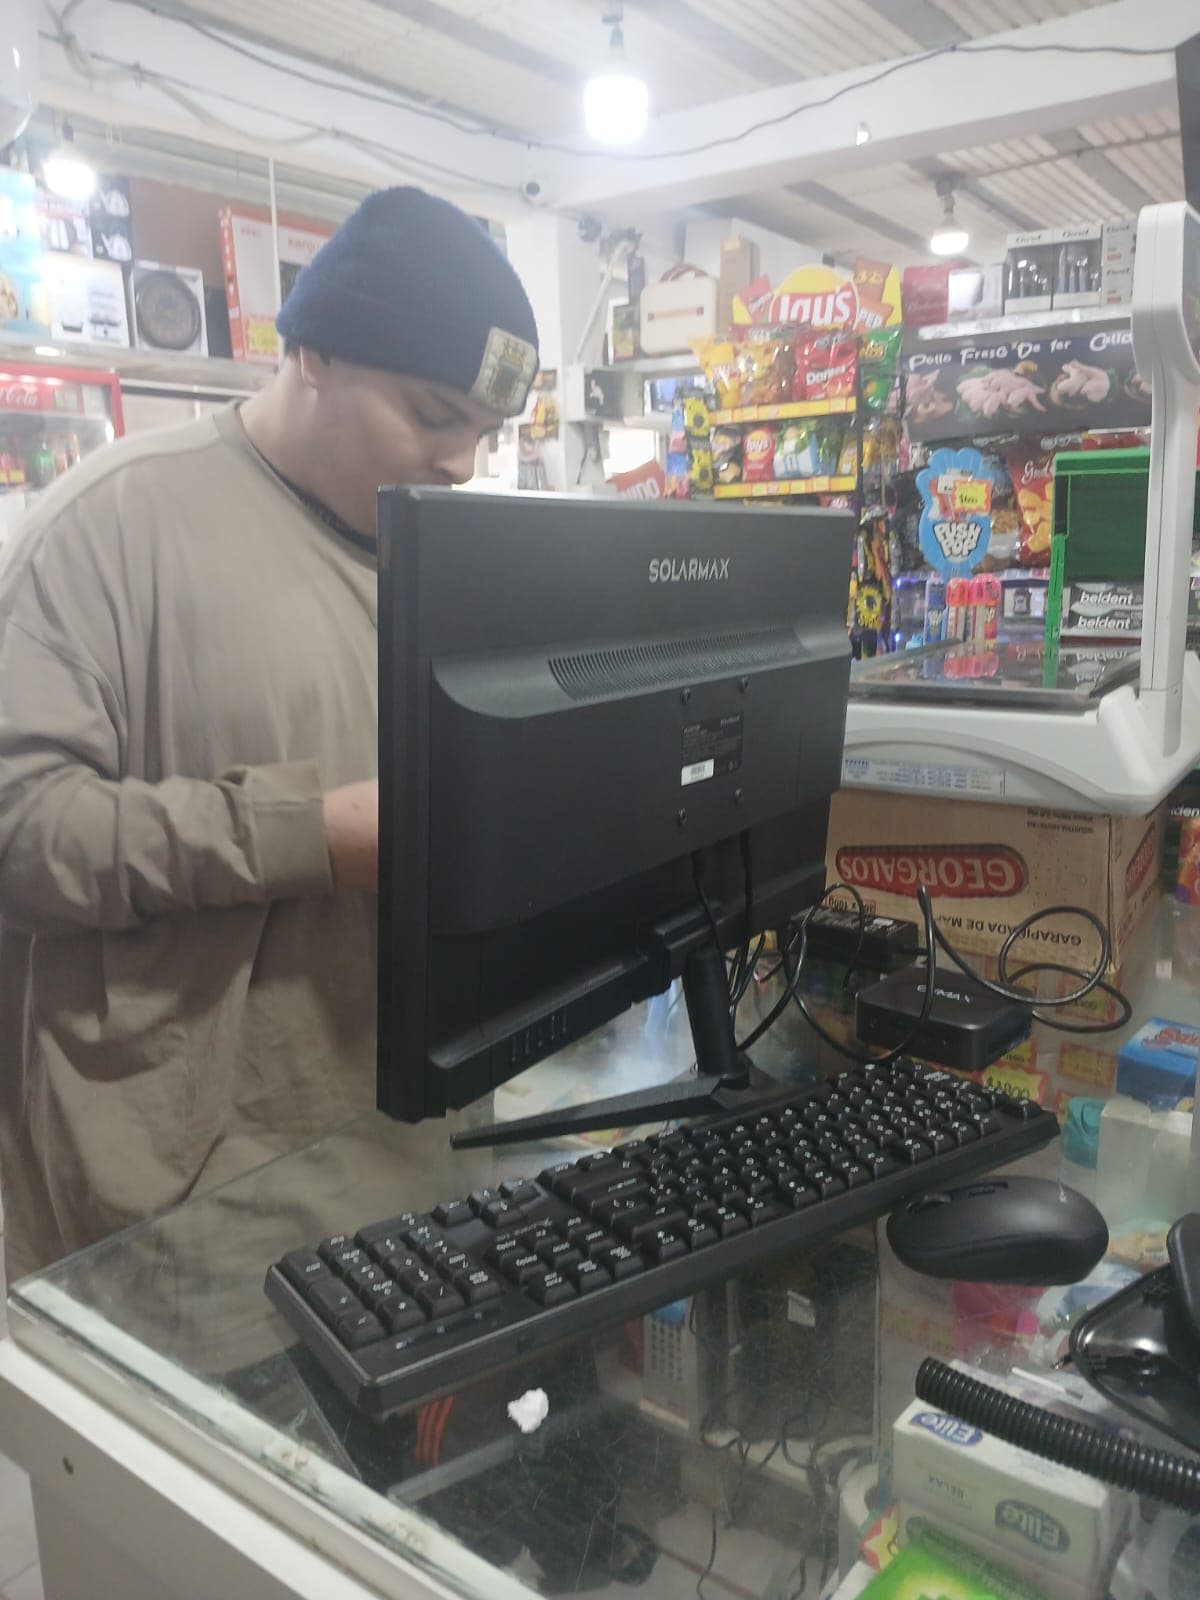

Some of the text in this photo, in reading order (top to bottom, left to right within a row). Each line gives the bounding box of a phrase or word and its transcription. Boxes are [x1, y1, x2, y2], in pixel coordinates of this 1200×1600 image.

[909, 352, 952, 371] Pollo
[1089, 330, 1133, 352] Calid
[934, 522, 983, 539] PUSH
[943, 537, 978, 556] POP
[648, 557, 731, 583] SOLARMAX
[1080, 591, 1133, 605] beldent
[1077, 616, 1131, 630] beldent
[839, 856, 1016, 891] GEORGALOS
[965, 918, 985, 932] DE
[921, 1413, 976, 1444] Elite
[1002, 1503, 1060, 1546] Elite
